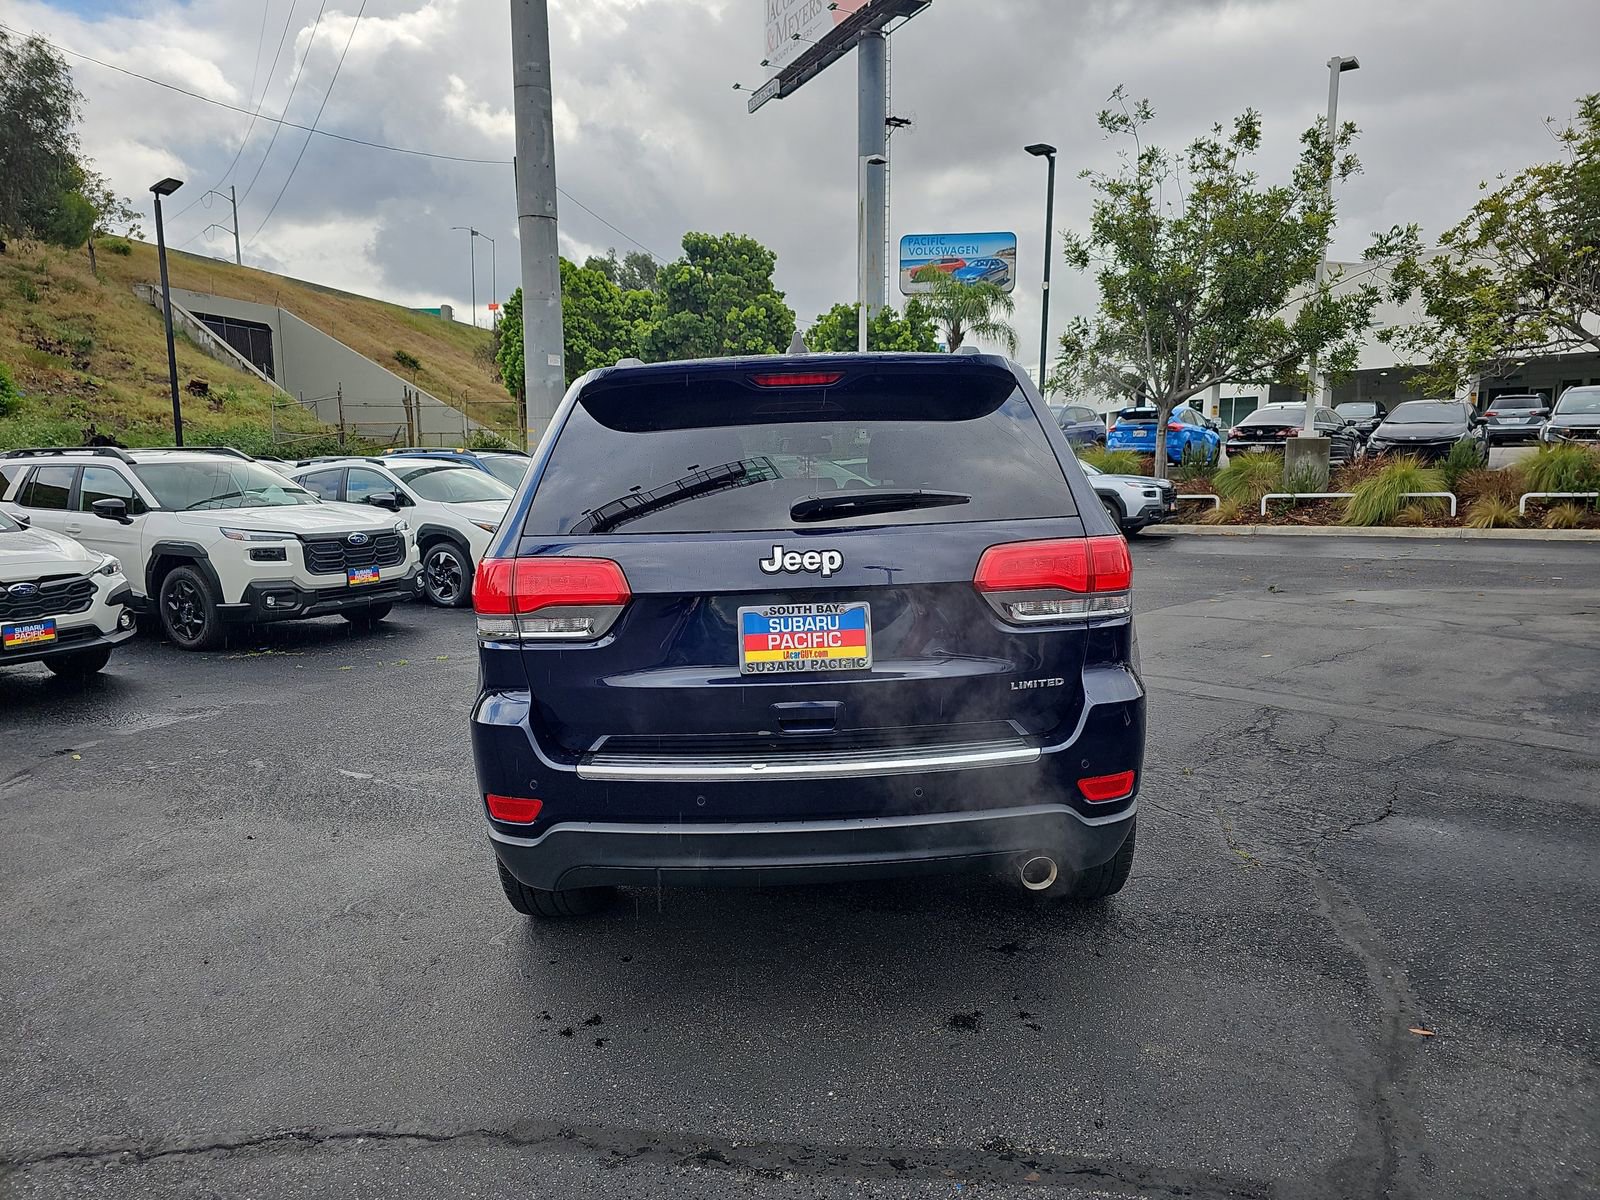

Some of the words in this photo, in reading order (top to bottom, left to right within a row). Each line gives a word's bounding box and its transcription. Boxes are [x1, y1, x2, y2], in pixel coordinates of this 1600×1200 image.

[776, 0, 822, 49] MEYERS
[908, 237, 946, 246] PACIFIC
[908, 246, 979, 256] VOLKSWAGEN
[761, 546, 843, 576] Jeep
[769, 605, 812, 616] SOUTH
[816, 604, 840, 614] BAY
[14, 624, 44, 634] SUBARU
[769, 615, 839, 633] SUBARU
[14, 630, 46, 640] PACIFIC
[768, 631, 842, 650] PACIFIC
[783, 650, 828, 660] LAcarGUY.com
[746, 660, 805, 673] SUBARU
[811, 658, 868, 670] PACIFIC
[1010, 677, 1065, 690] LIMITED
